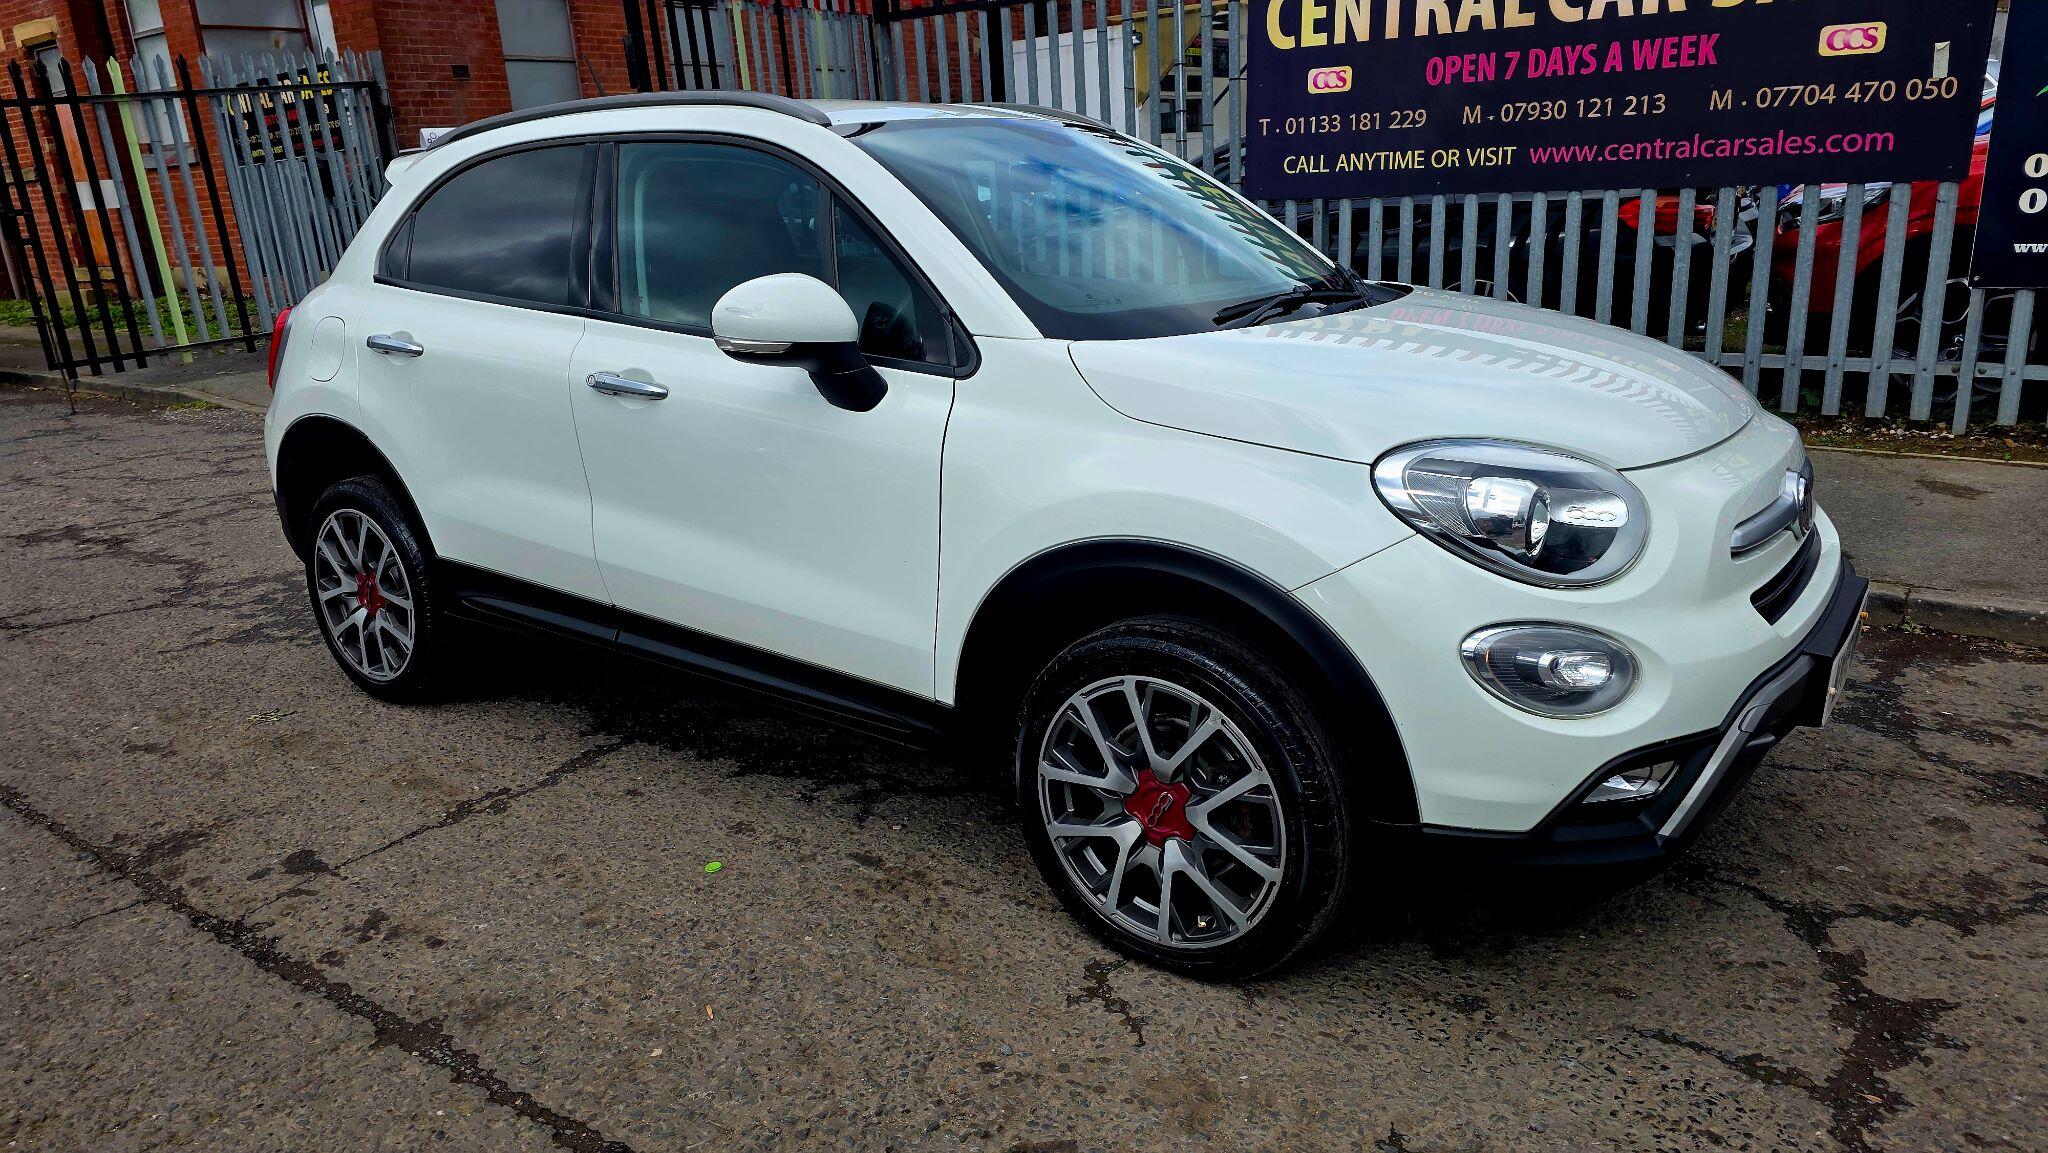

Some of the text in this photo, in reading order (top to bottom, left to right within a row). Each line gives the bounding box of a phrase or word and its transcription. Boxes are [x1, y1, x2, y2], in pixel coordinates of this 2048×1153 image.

[1826, 26, 1879, 52] CCS
[1426, 33, 1720, 86] OPEN 7 DAYS A WEEK
[1312, 69, 1348, 91] CCS
[1756, 83, 1837, 109] 07704
[1844, 80, 1897, 104] 470
[1905, 76, 1958, 101] 050
[1285, 114, 1342, 136] 01133
[1349, 112, 1381, 132] 181
[1388, 109, 1428, 130] 229
[1500, 99, 1568, 123] 07930
[1577, 97, 1613, 118] 121
[1623, 93, 1666, 117] 213
[1283, 130, 1895, 174] CALL ANYTIME OR VISIT www.centralcarsales.com
